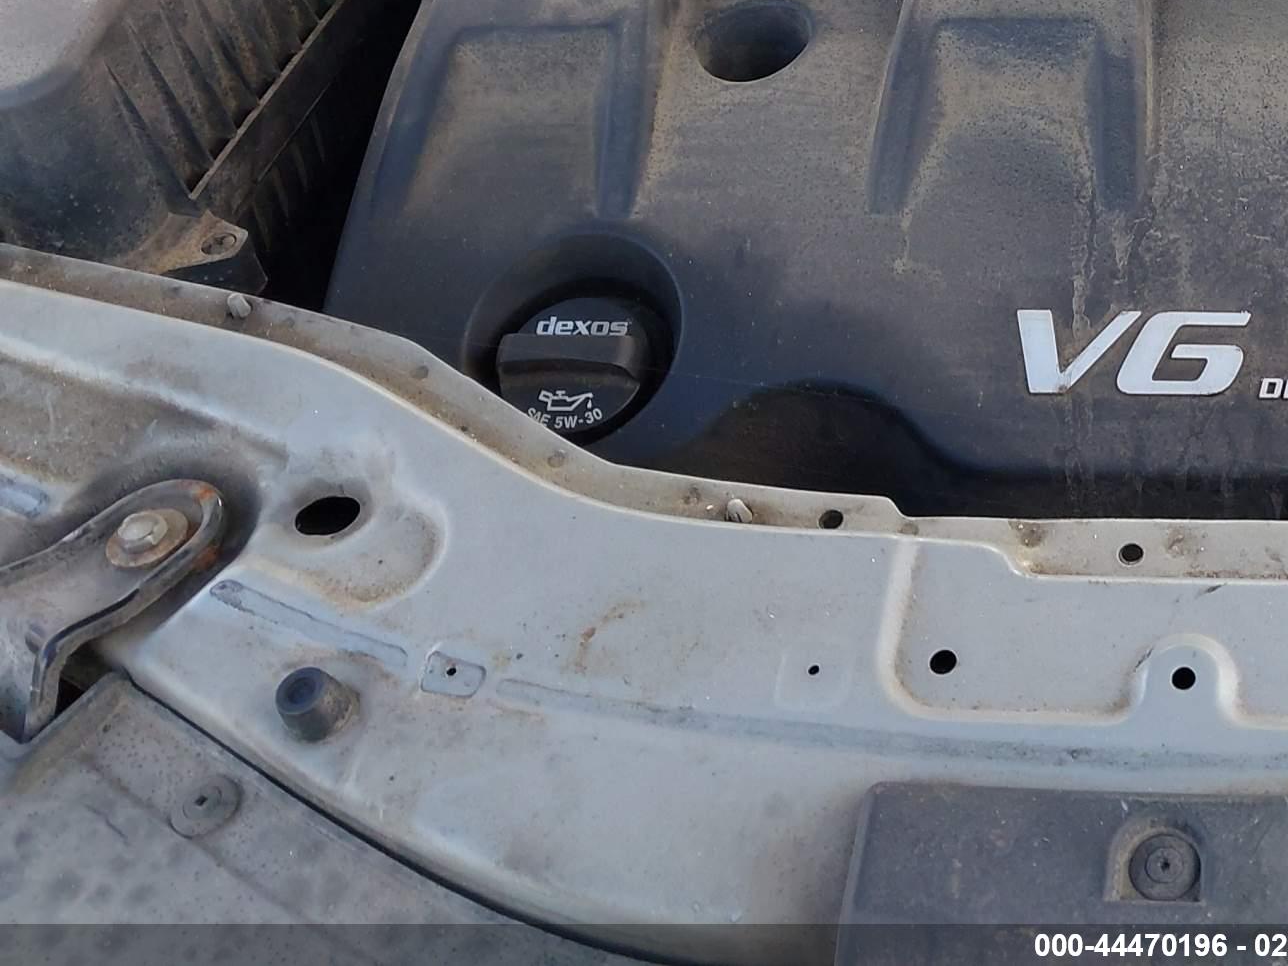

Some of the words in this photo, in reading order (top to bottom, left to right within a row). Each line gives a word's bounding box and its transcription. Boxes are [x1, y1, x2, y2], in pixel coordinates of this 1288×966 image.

[537, 316, 628, 336] dexos
[1017, 309, 1252, 396] V6
[554, 408, 603, 429] 5W-30
